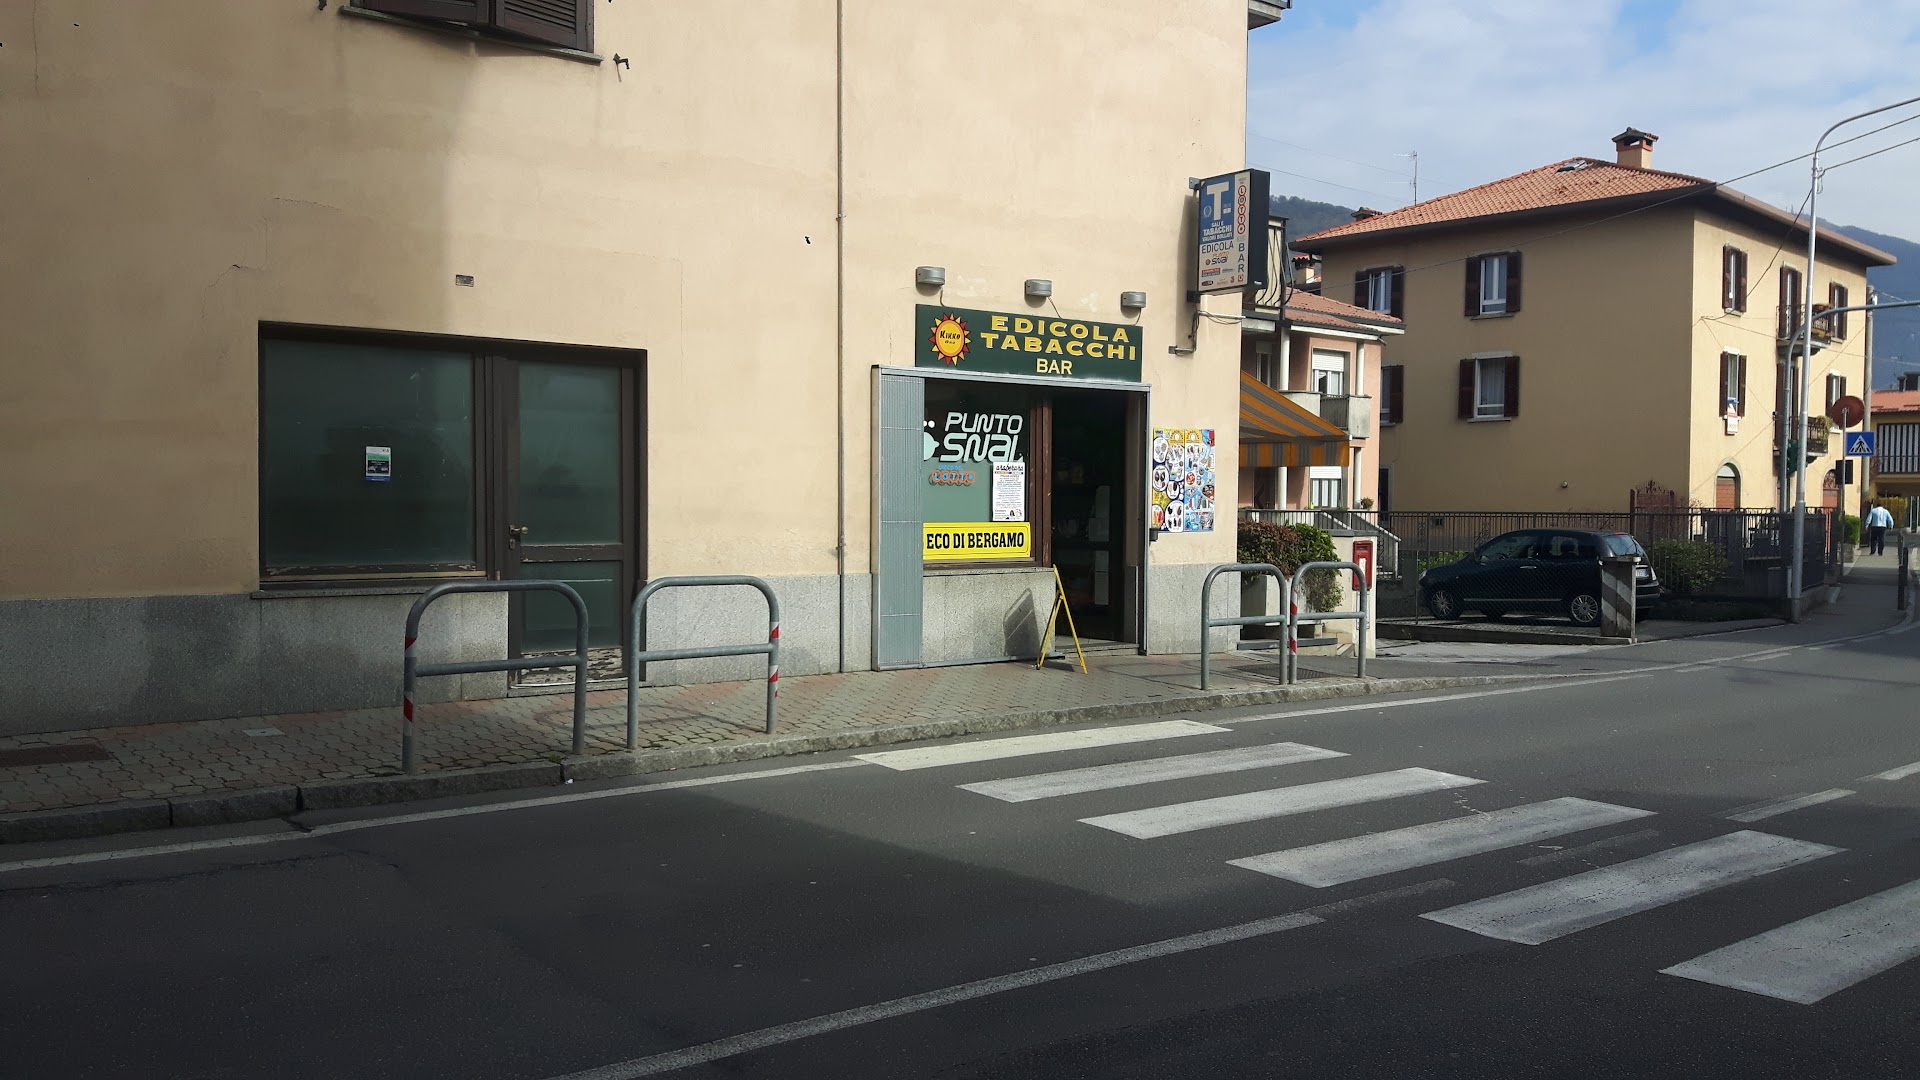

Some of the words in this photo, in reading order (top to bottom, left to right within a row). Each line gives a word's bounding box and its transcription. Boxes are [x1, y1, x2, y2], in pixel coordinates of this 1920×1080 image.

[1207, 181, 1229, 220] T
[1238, 185, 1246, 234] LOTTO
[1203, 225, 1232, 236] TABACCHI
[1202, 241, 1234, 254] EDICOLA
[991, 315, 1130, 343] EDICOLA
[980, 332, 1136, 360] TABACCHI
[1036, 357, 1073, 375] BAR
[944, 411, 1024, 434] PUNTO
[926, 533, 950, 549] ECO
[953, 533, 965, 549] DI
[967, 532, 1024, 549] BERGAMO
